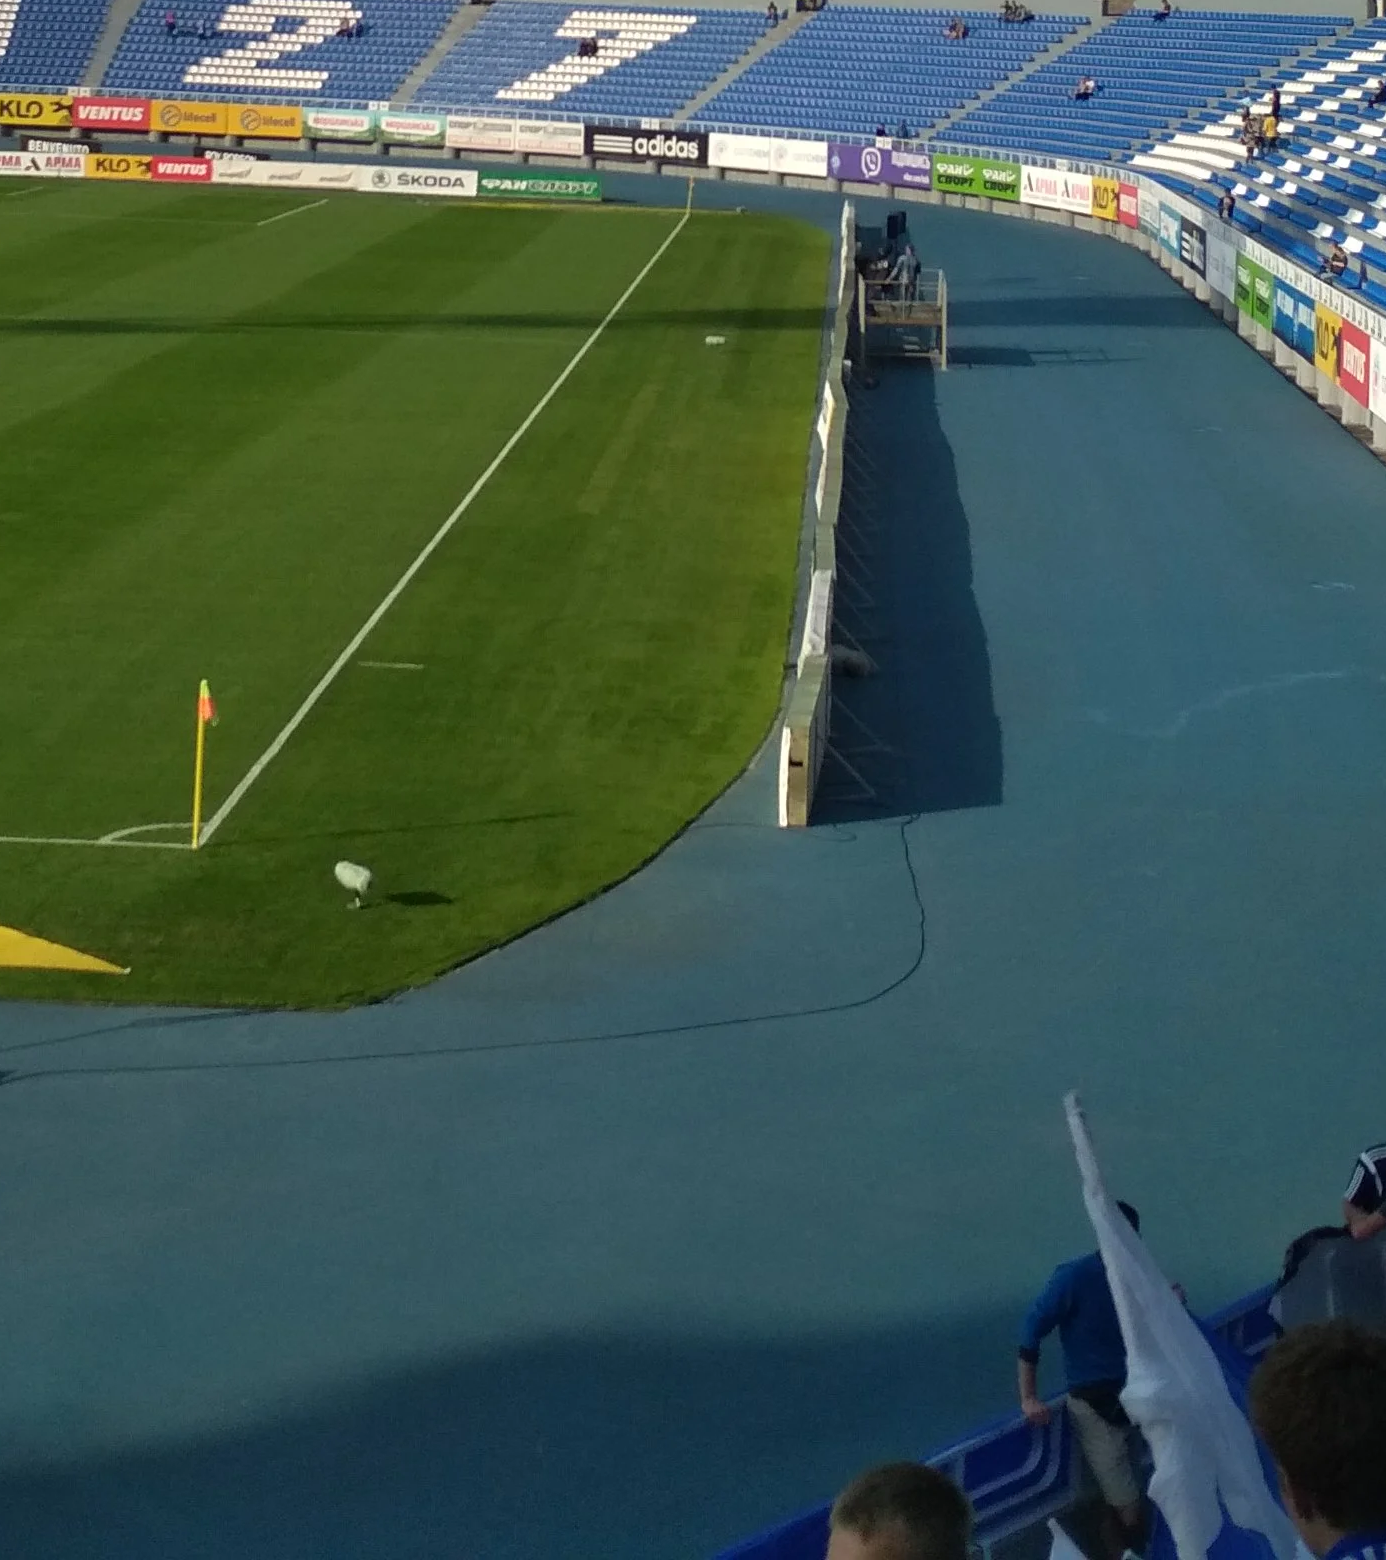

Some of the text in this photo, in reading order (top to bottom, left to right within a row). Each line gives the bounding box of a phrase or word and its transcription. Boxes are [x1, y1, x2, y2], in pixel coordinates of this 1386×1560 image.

[77, 105, 145, 122] VENTUS
[634, 134, 700, 159] adidas
[95, 158, 131, 173] KLO
[157, 161, 208, 175] VENTUS
[396, 172, 466, 189] ŠKODA
